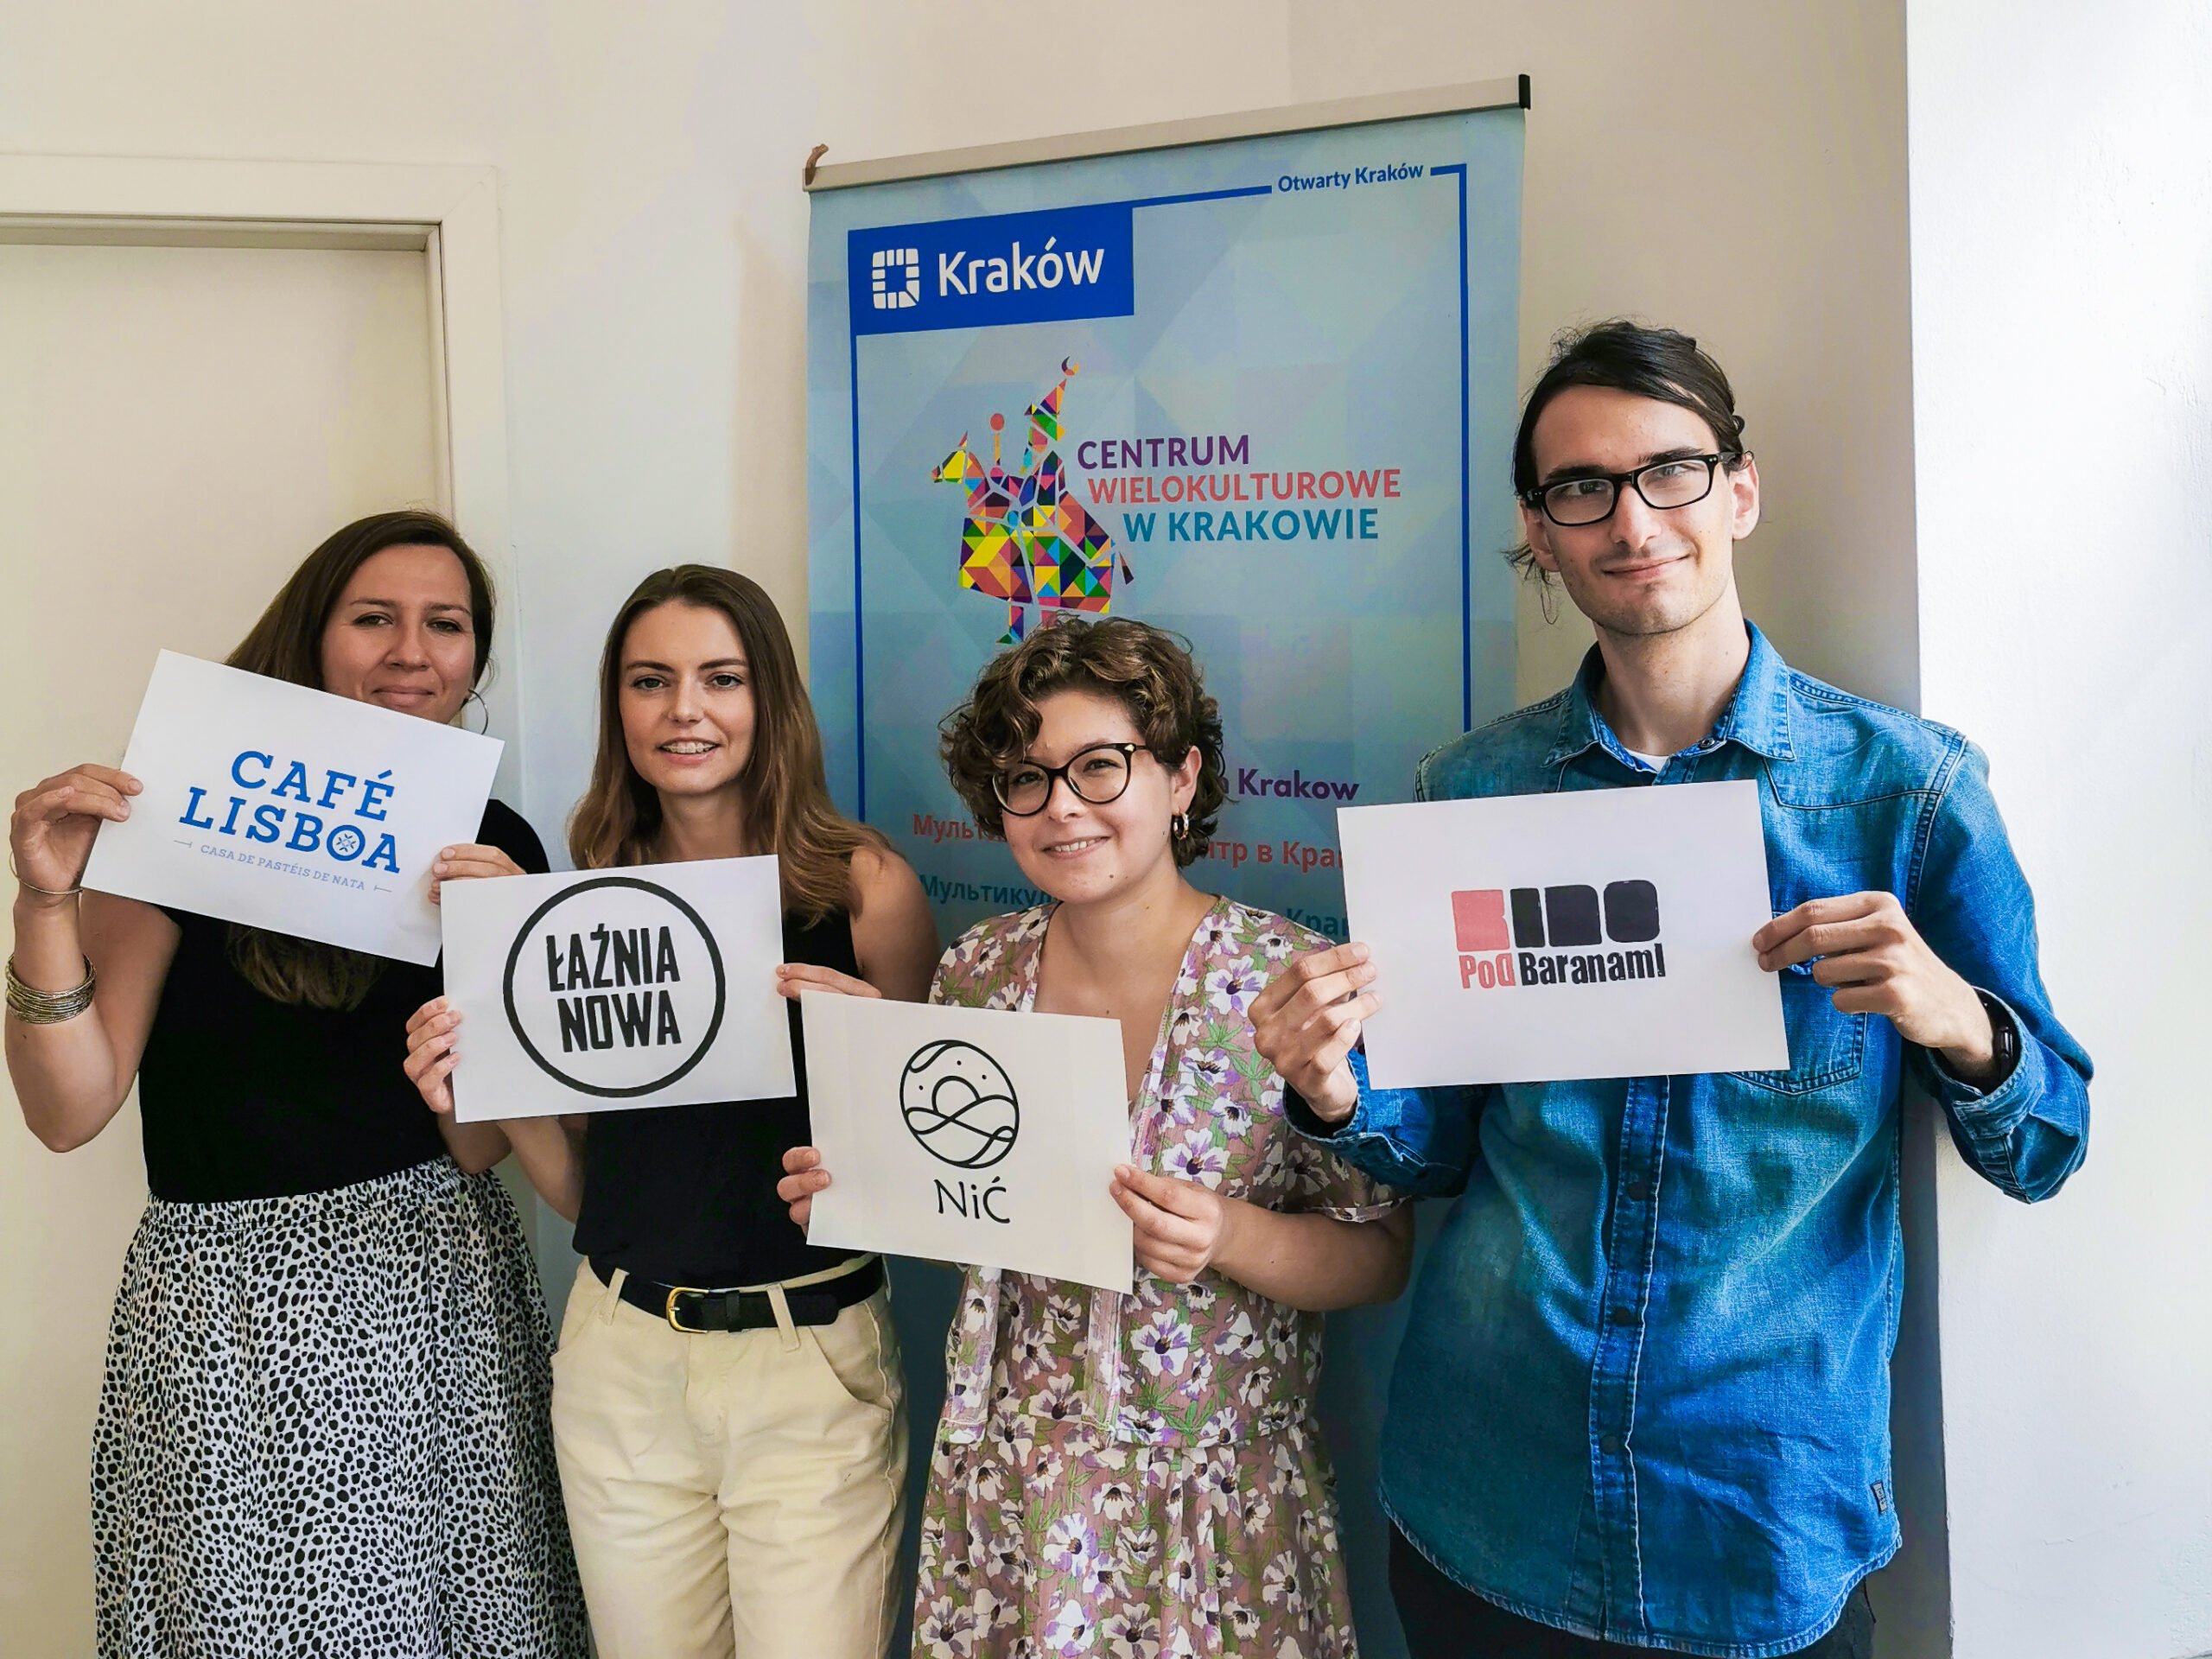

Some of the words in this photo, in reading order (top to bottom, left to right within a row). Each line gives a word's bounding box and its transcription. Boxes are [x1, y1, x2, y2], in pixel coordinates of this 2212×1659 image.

[1278, 171, 1351, 192] Otwarty
[1355, 162, 1424, 184] Kraków
[938, 237, 1104, 296] Kraków
[1077, 435, 1249, 469] CENTRUM
[1088, 468, 1401, 504] WIELOKULTUROWE
[1123, 512, 1156, 542] W
[1169, 508, 1379, 542] KRAKOWIE
[232, 751, 395, 821] CAFÉ
[1238, 768, 1360, 801] Krakow
[179, 786, 400, 874] LISBOA
[200, 844, 236, 861] CASA
[237, 853, 254, 865] DE
[257, 857, 310, 878] PASTÉIS
[313, 870, 330, 882] DE
[333, 874, 365, 891] NATA
[1257, 844, 1273, 863] в
[546, 923, 681, 992] ŁAŹNIA
[557, 990, 682, 1052] NOWA
